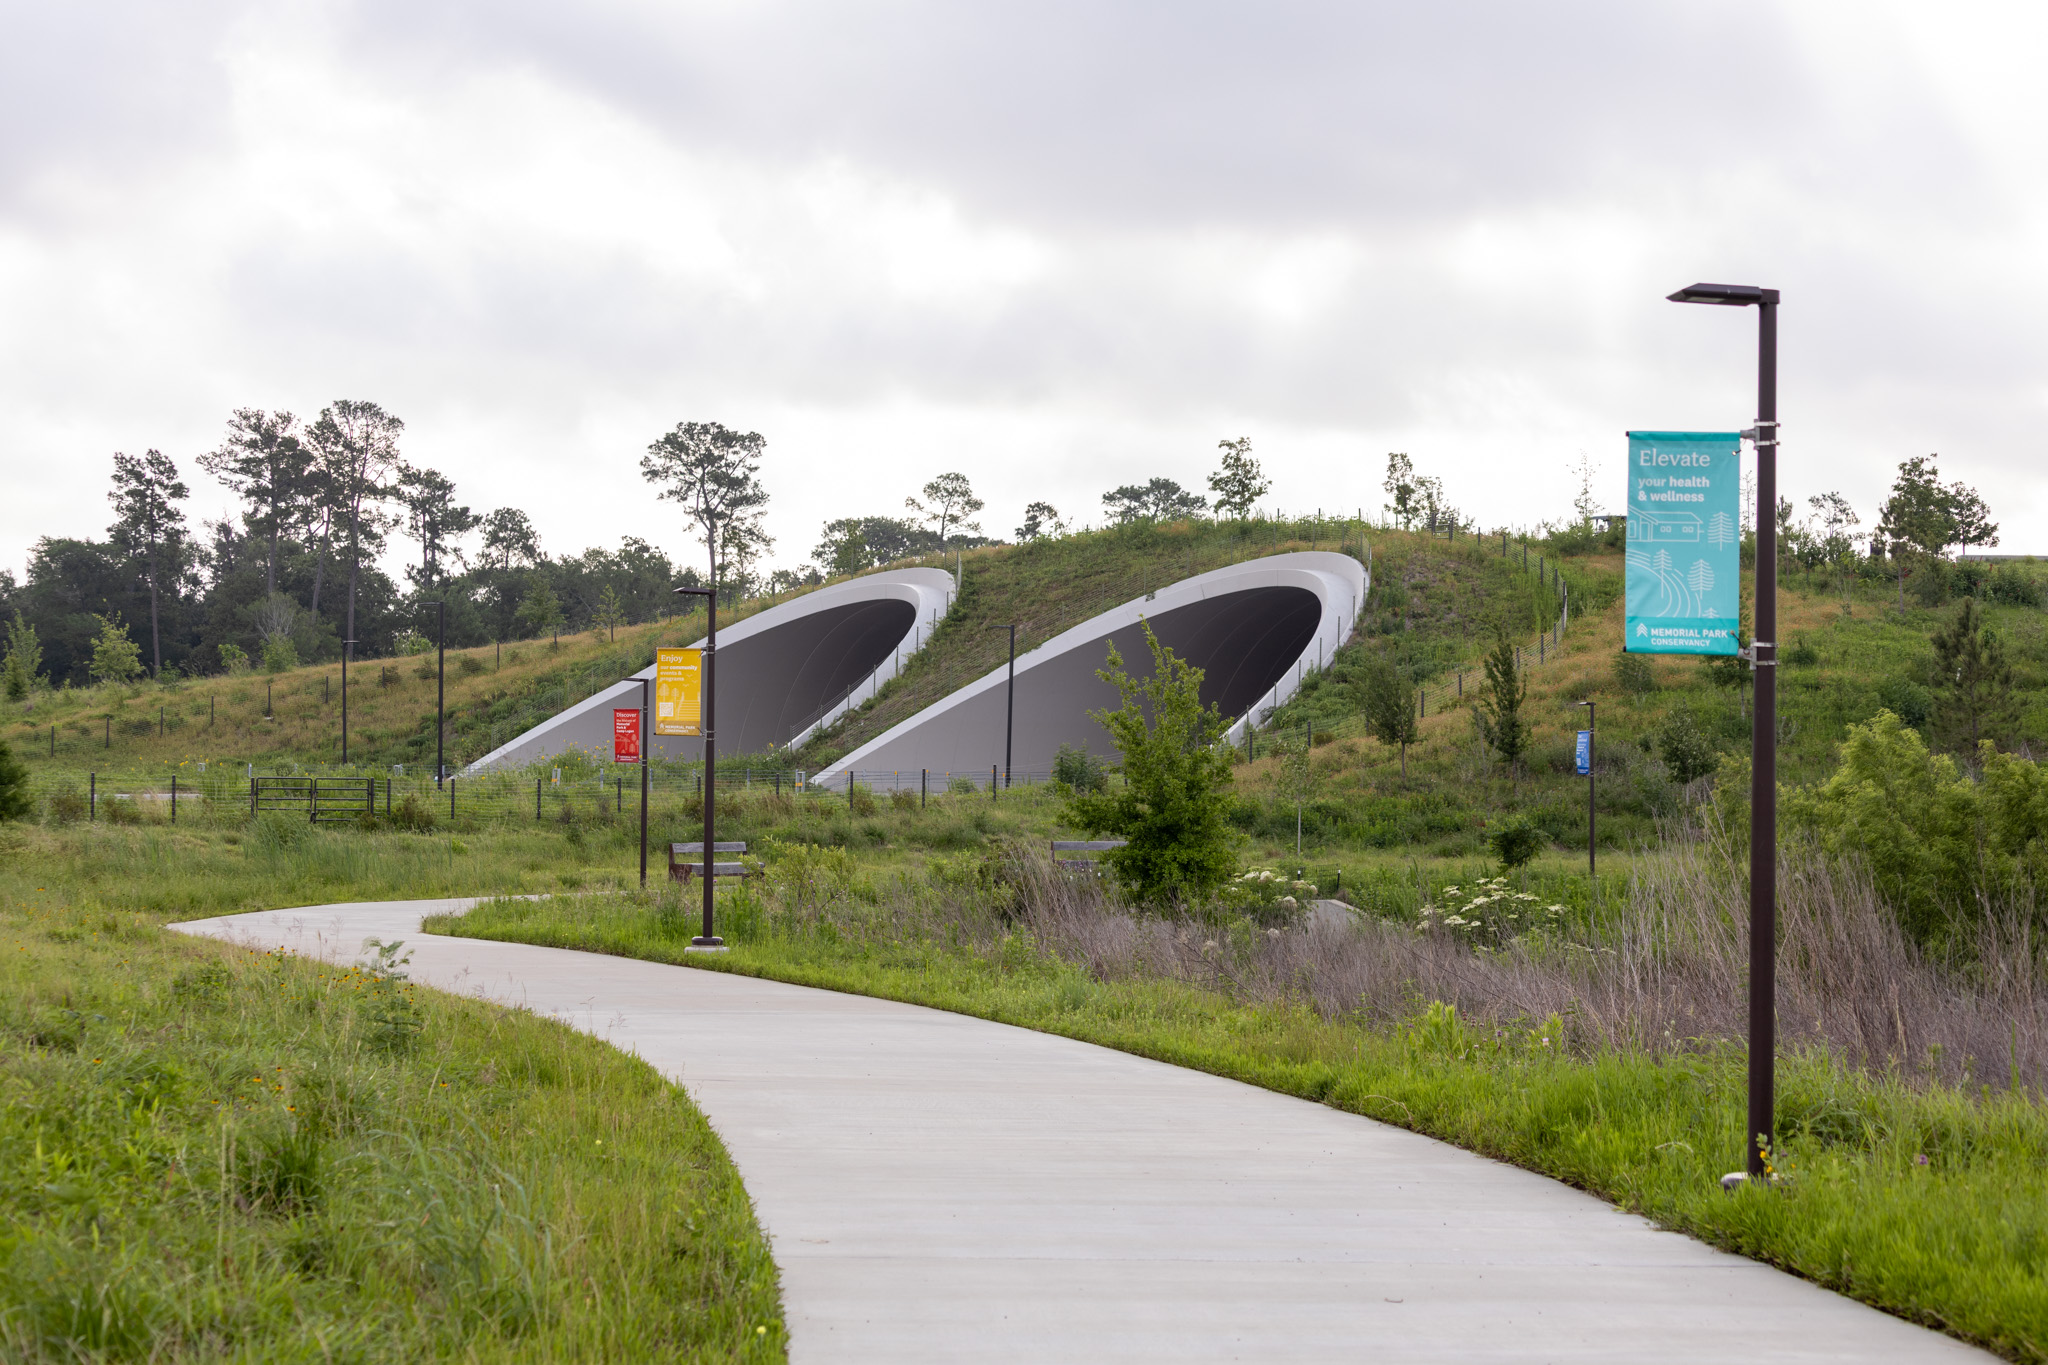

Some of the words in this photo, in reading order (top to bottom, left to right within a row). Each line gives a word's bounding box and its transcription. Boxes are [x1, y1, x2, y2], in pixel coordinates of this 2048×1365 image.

[1640, 447, 1711, 467] Elevate
[1638, 477, 1666, 489] your
[1669, 475, 1710, 487] health
[1638, 490, 1647, 501] &
[1650, 490, 1705, 502] wellness
[1650, 628, 1701, 637] MEMORIAL
[1703, 629, 1728, 638] PARK
[1650, 638, 1711, 647] CONSERVANCY
[660, 654, 683, 663] Enjoy
